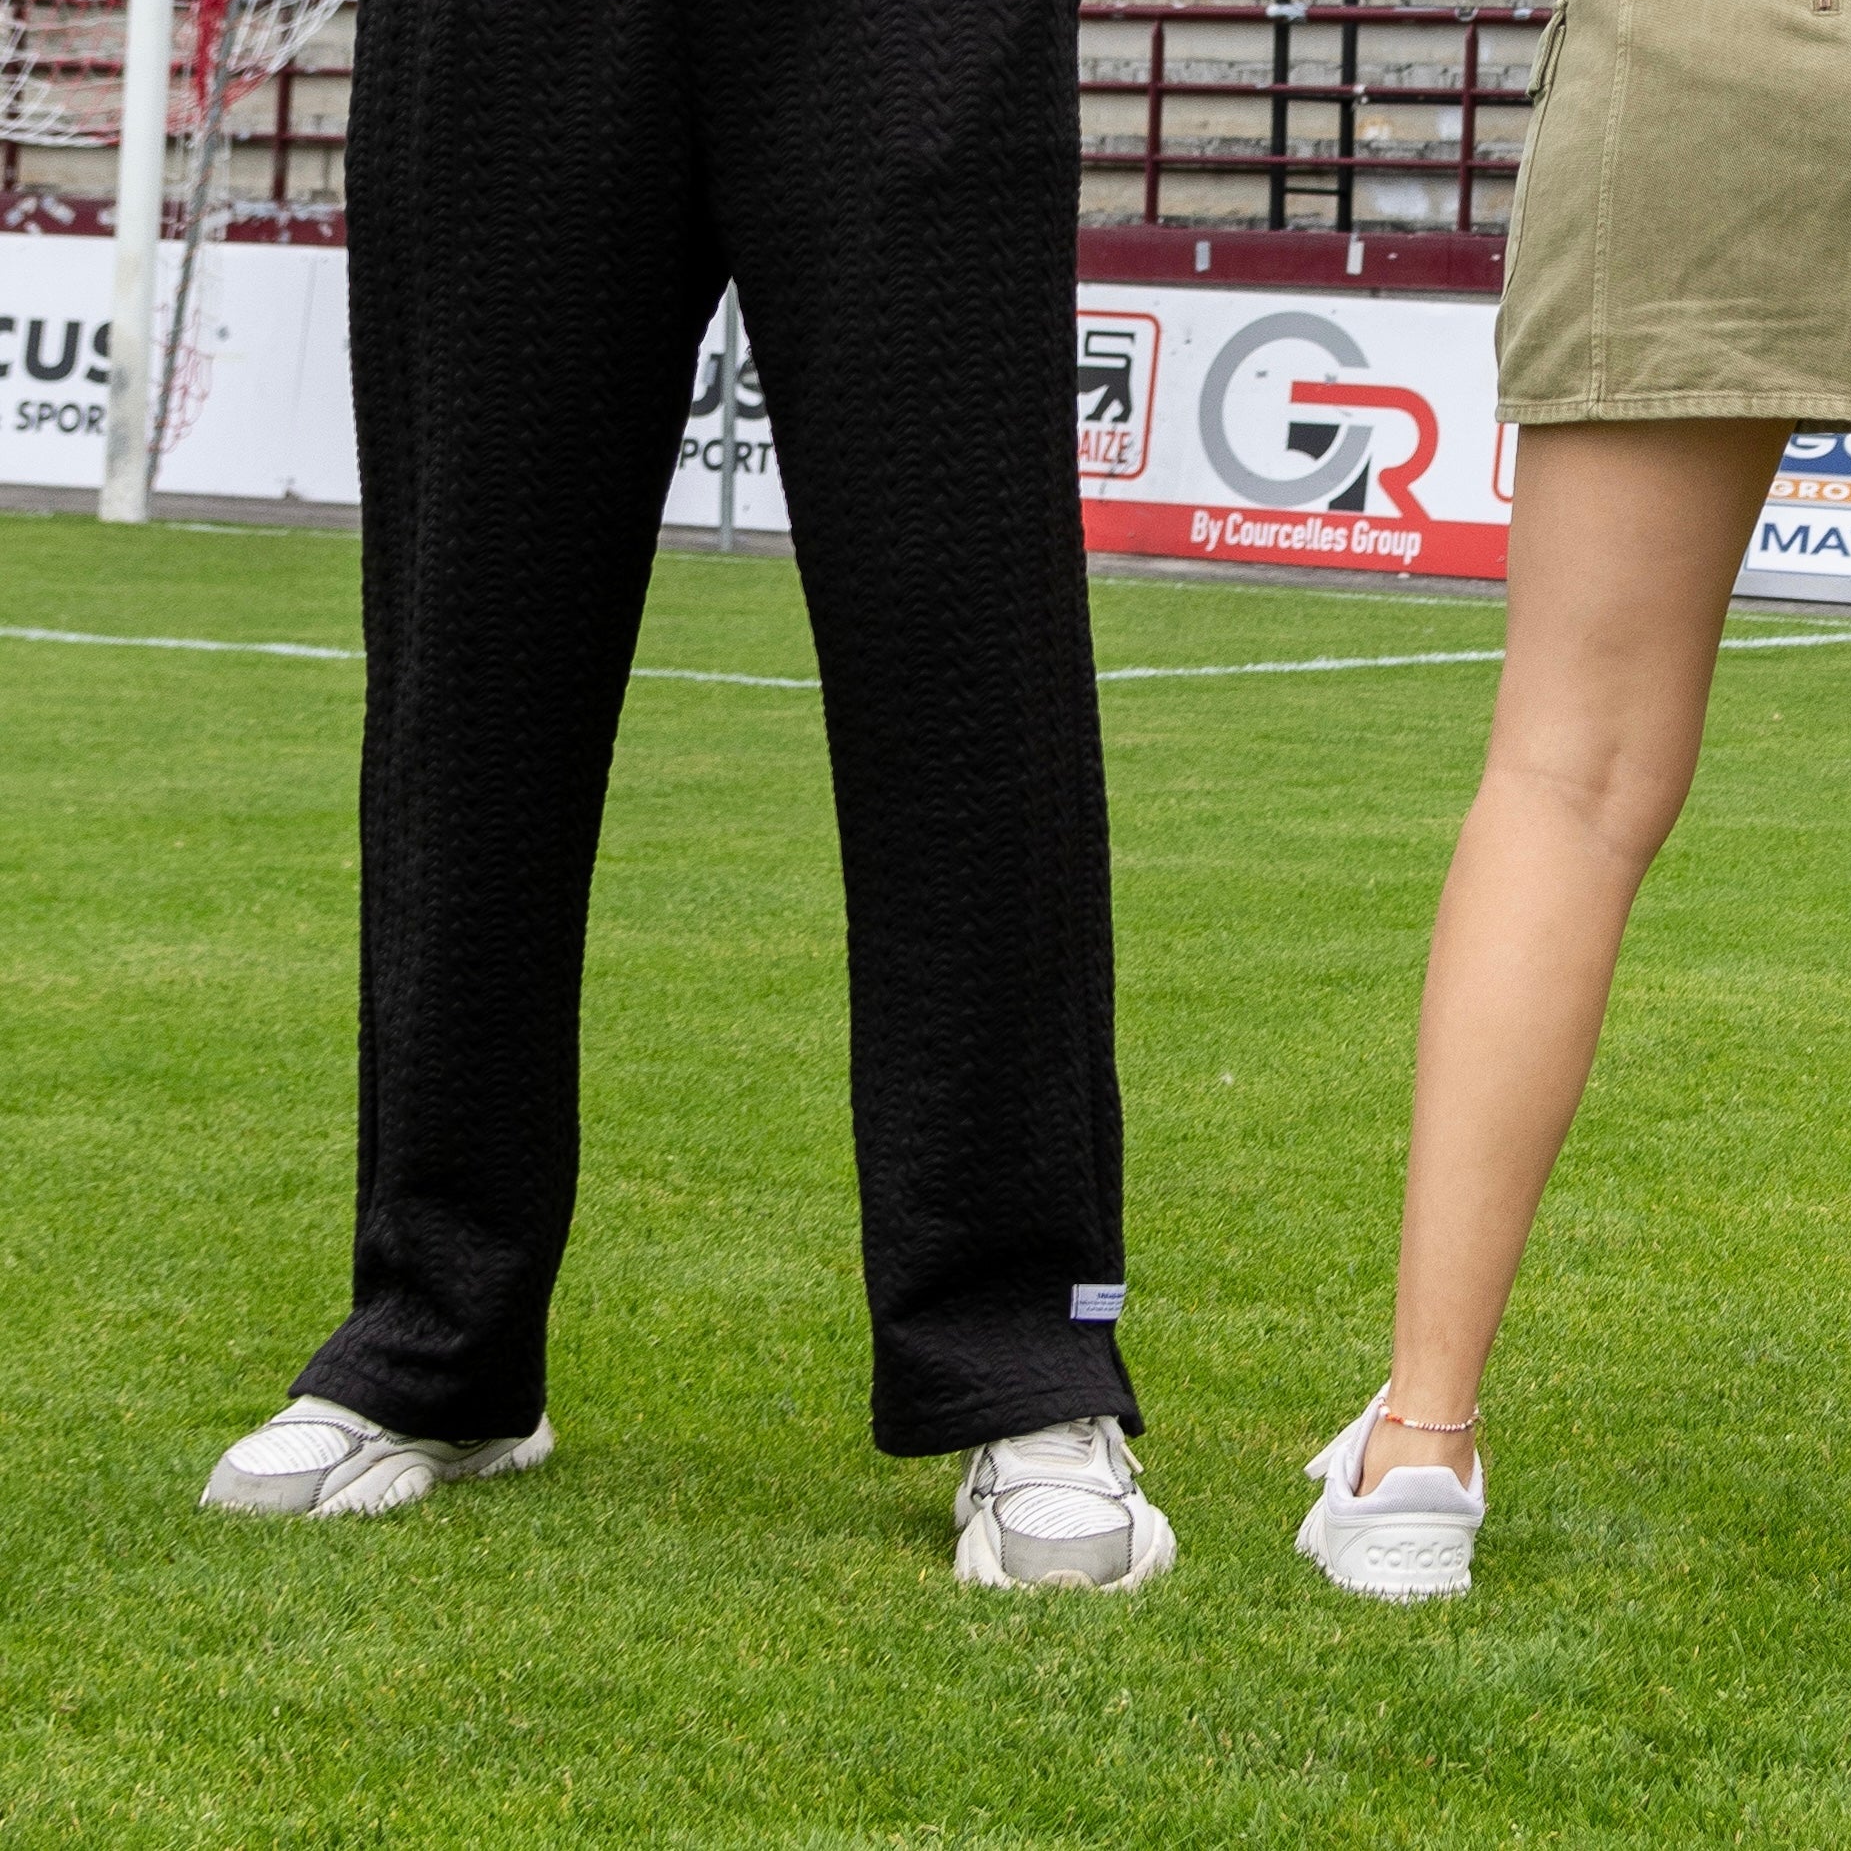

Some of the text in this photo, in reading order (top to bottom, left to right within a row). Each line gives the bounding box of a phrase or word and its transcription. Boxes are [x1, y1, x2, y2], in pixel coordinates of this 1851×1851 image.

[1190, 509, 1423, 566] By Courcelles Group
[1366, 1540, 1466, 1574] adidas
